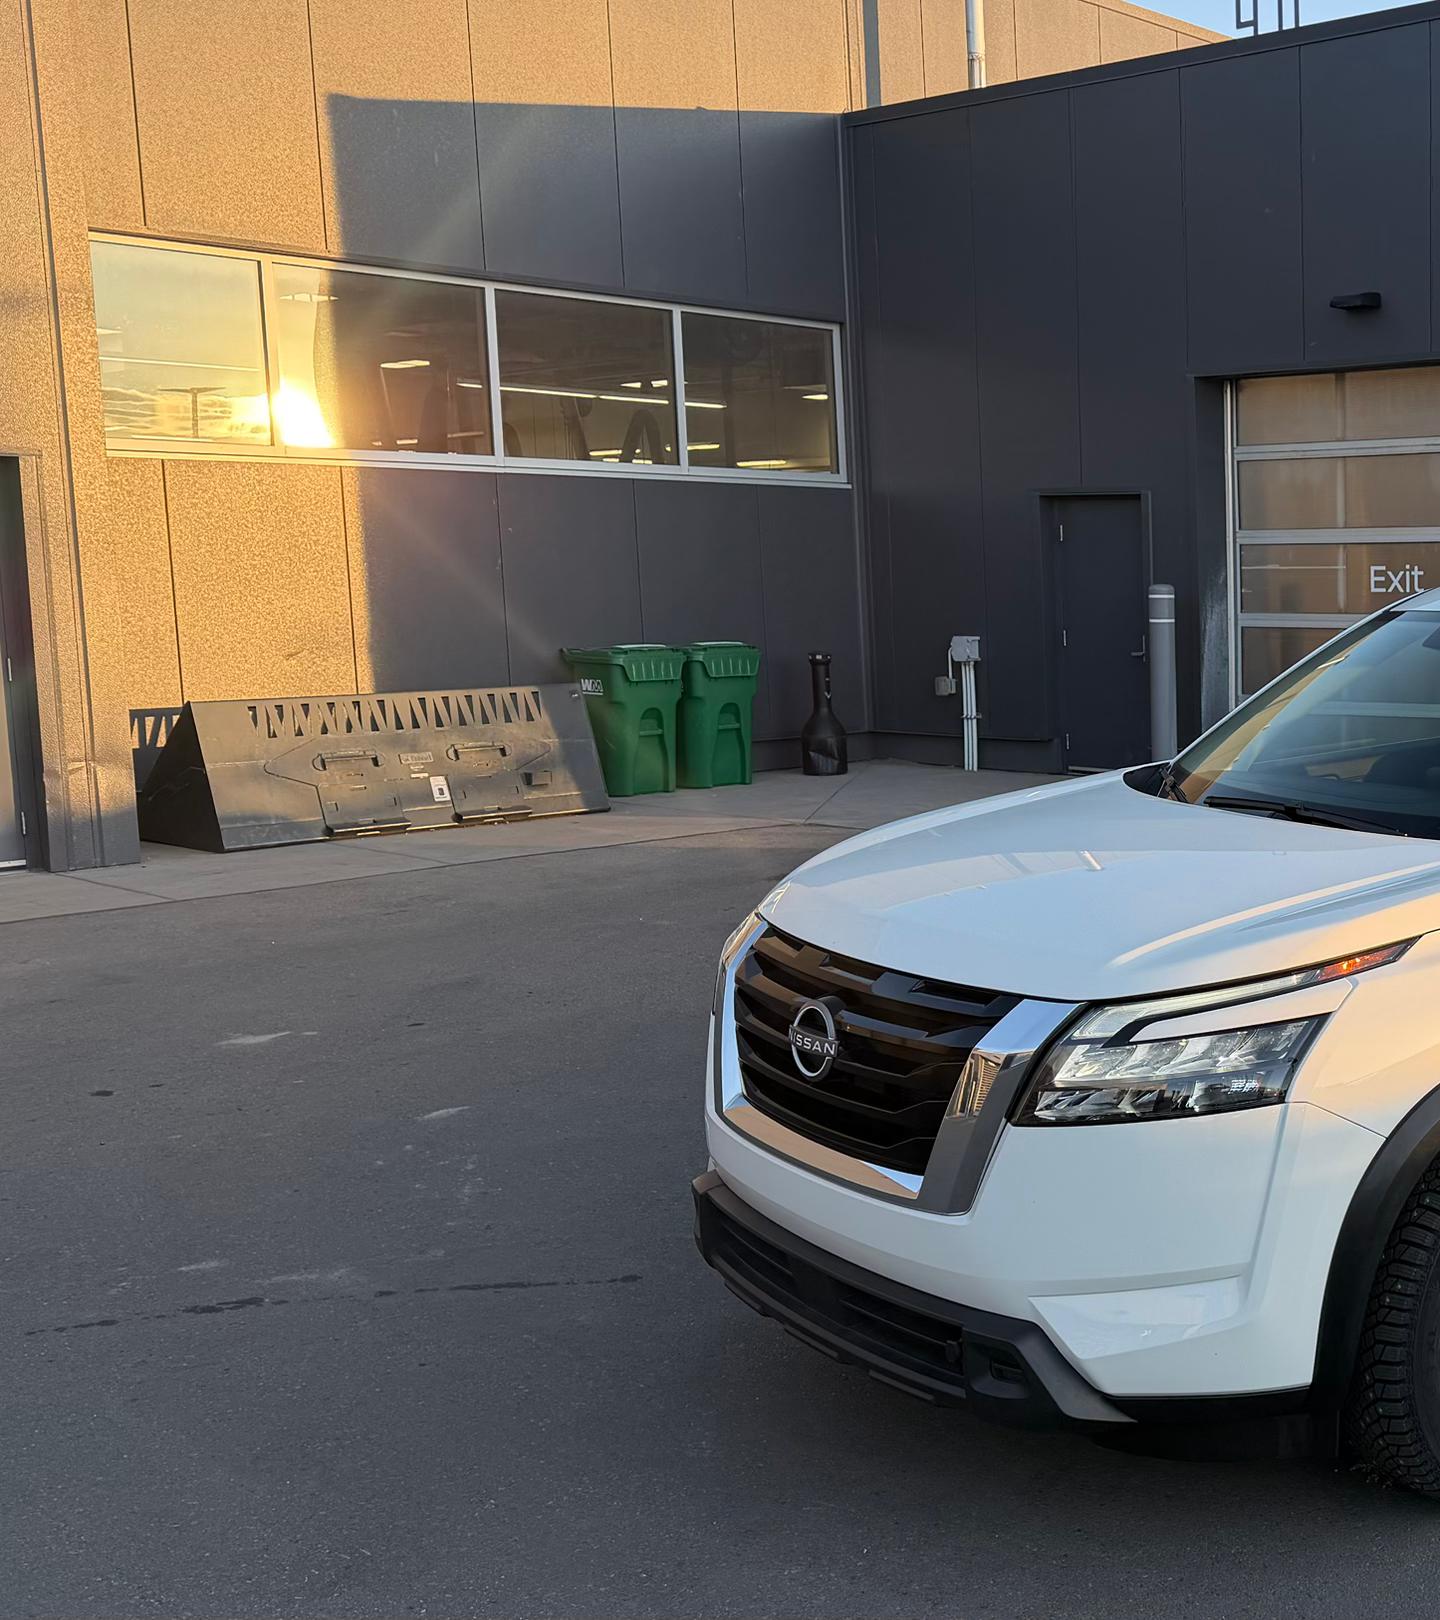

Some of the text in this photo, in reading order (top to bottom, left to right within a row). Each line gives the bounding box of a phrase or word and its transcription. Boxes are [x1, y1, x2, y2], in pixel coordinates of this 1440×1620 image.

[1370, 564, 1425, 593] Exit
[581, 679, 604, 692] WM
[788, 1024, 836, 1056] NISSAN
